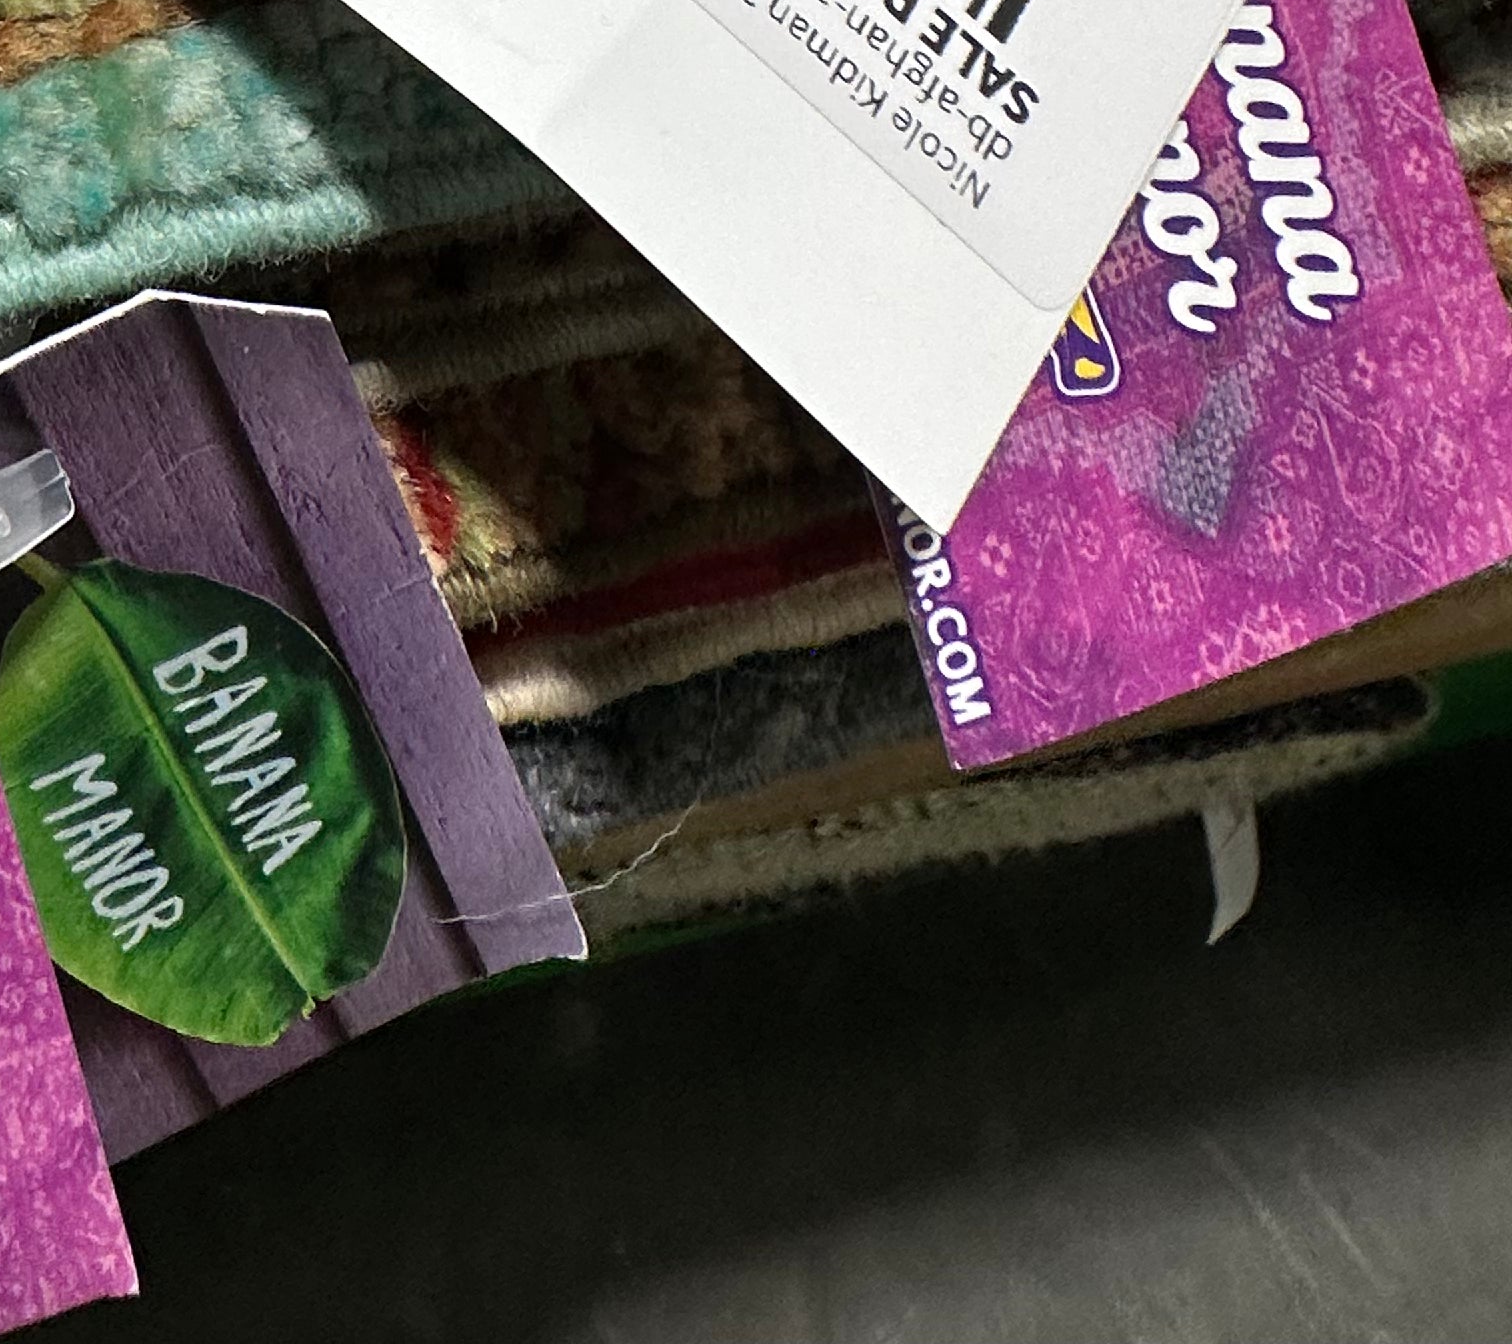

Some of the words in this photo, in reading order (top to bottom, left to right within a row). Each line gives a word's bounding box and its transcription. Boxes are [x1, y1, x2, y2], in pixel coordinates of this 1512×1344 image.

[918, 8, 1040, 124] SALE
[892, 106, 990, 208] Nicole
[153, 624, 323, 875] BANANA
[29, 752, 185, 953] MANOR
